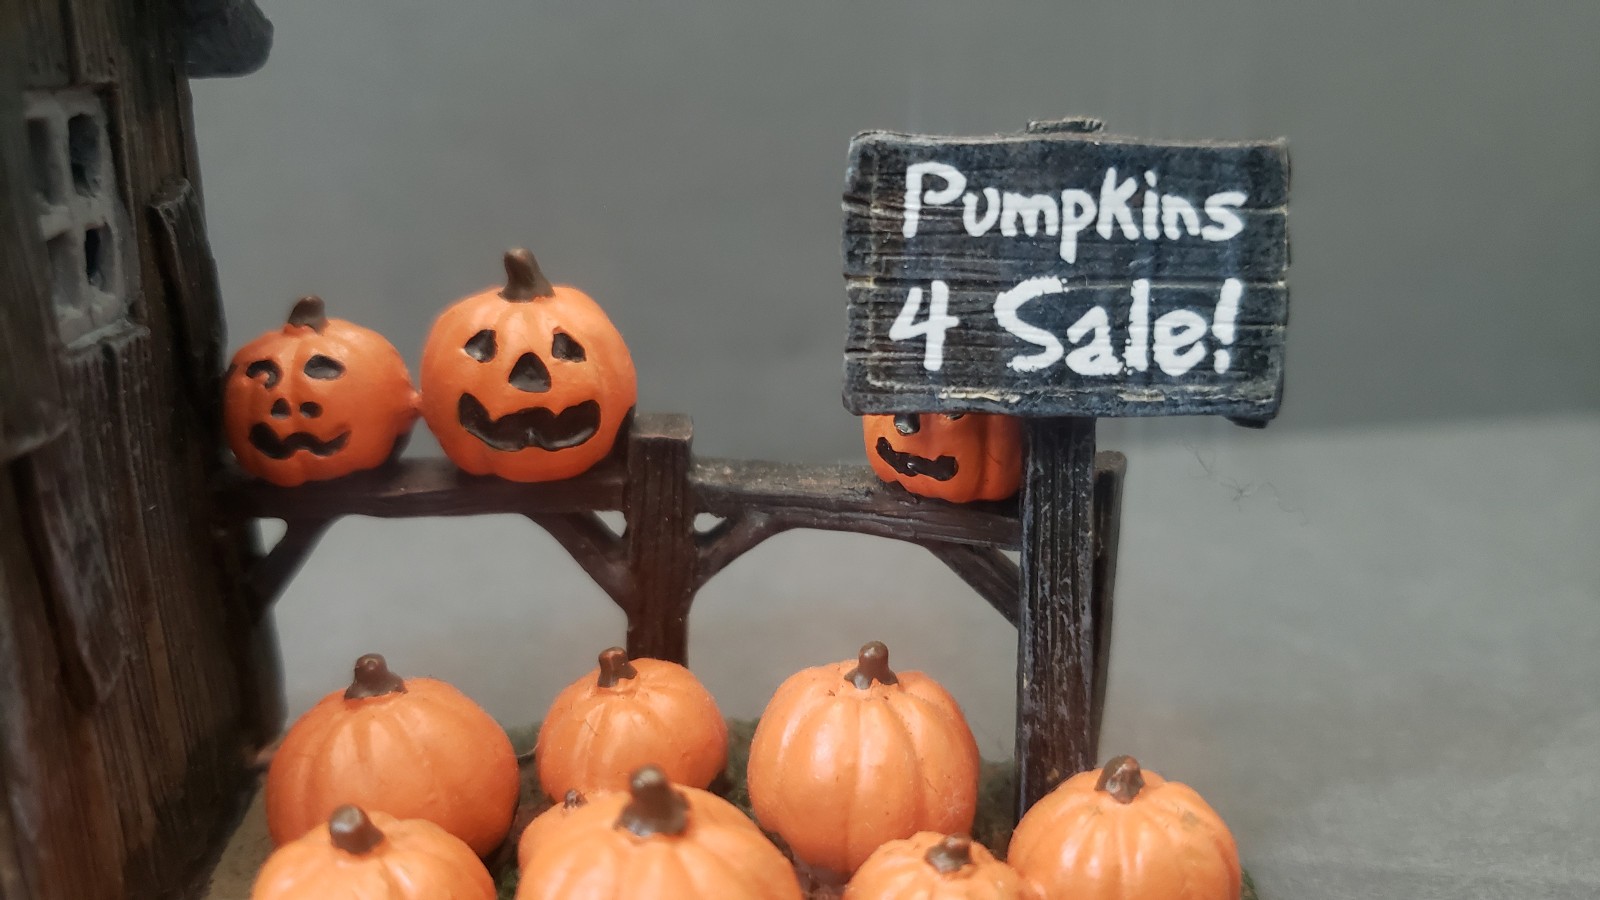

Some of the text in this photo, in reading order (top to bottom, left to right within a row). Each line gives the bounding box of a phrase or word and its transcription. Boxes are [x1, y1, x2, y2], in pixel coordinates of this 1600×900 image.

[902, 161, 1248, 263] Pumpkins
[888, 275, 1244, 377] 4 Sale!
